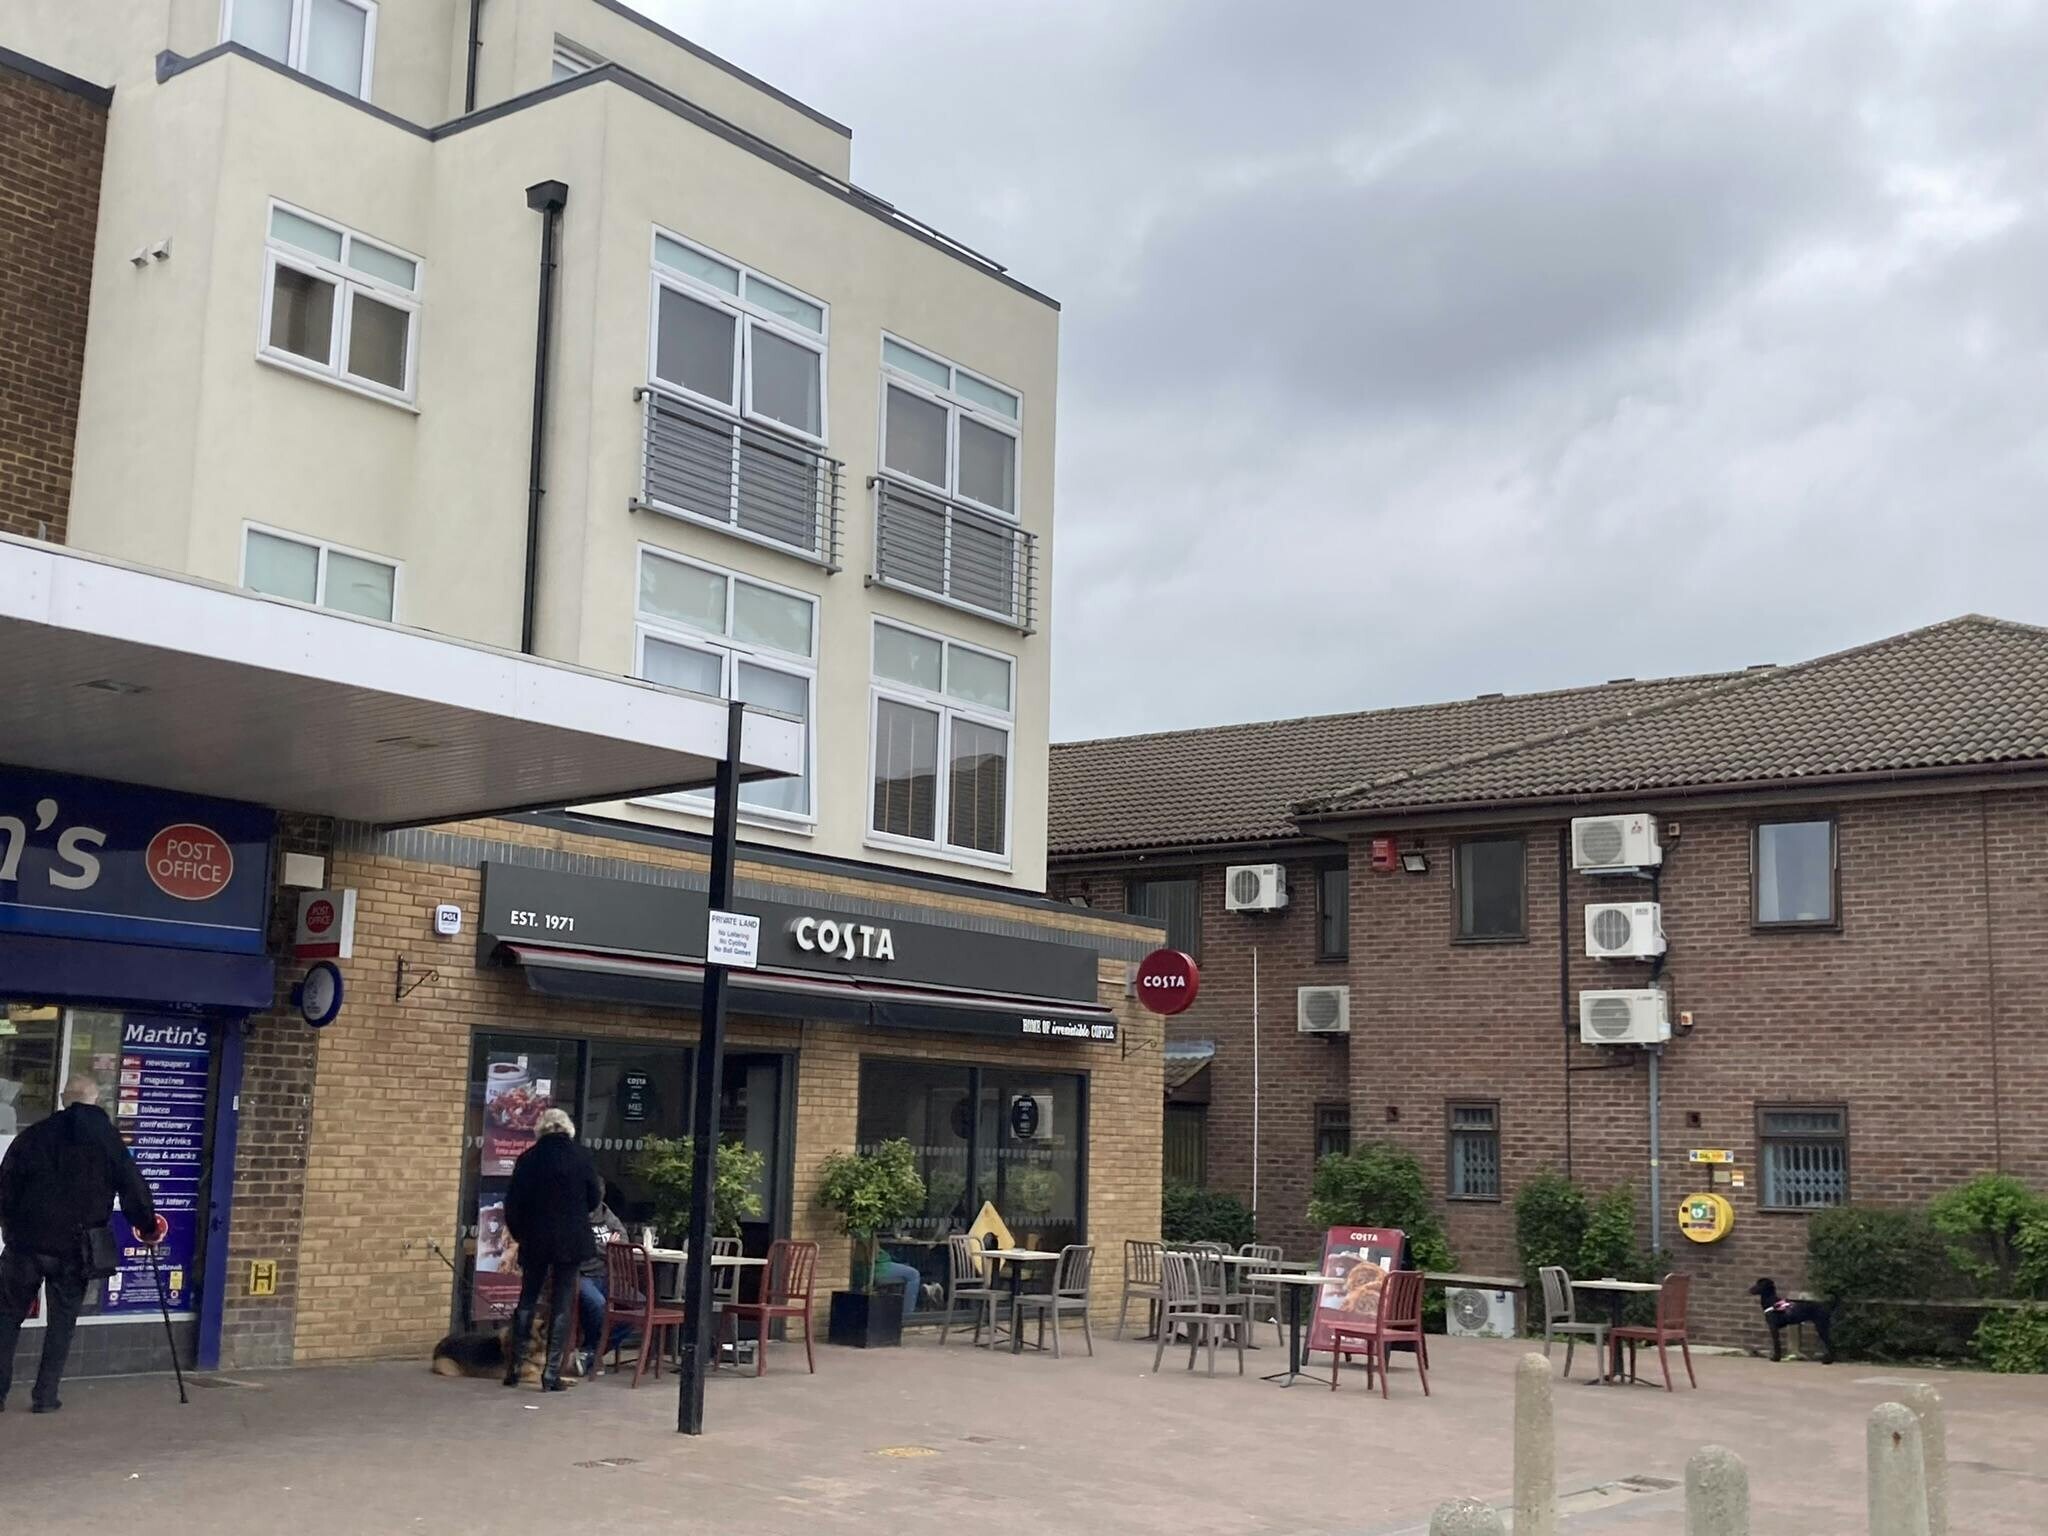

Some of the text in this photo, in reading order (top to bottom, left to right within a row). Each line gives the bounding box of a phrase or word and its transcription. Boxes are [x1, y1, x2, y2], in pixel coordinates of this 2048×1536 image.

[167, 839, 216, 861] POST
[157, 858, 222, 883] OFFICE
[510, 910, 575, 932] EST. 1971
[711, 914, 758, 929] PRIVATE LAND
[718, 929, 726, 937] No
[796, 916, 895, 961] COSTA
[714, 945, 722, 953] No
[727, 939, 747, 949] Cycling
[1143, 975, 1186, 989] COSTA
[1022, 1018, 1041, 1033] HOME
[1042, 1020, 1051, 1034] OF
[1091, 1025, 1115, 1039] COFFEE
[124, 1023, 208, 1046] Martin's
[145, 1059, 191, 1070] newspapers
[143, 1076, 185, 1086] magazines
[141, 1105, 171, 1114] tobacco
[140, 1120, 192, 1131] confectionery
[138, 1136, 192, 1146] chilled drinks
[137, 1151, 197, 1161] crisps & snacks
[141, 1167, 170, 1177] atteries
[1350, 1232, 1378, 1241] COSTA
